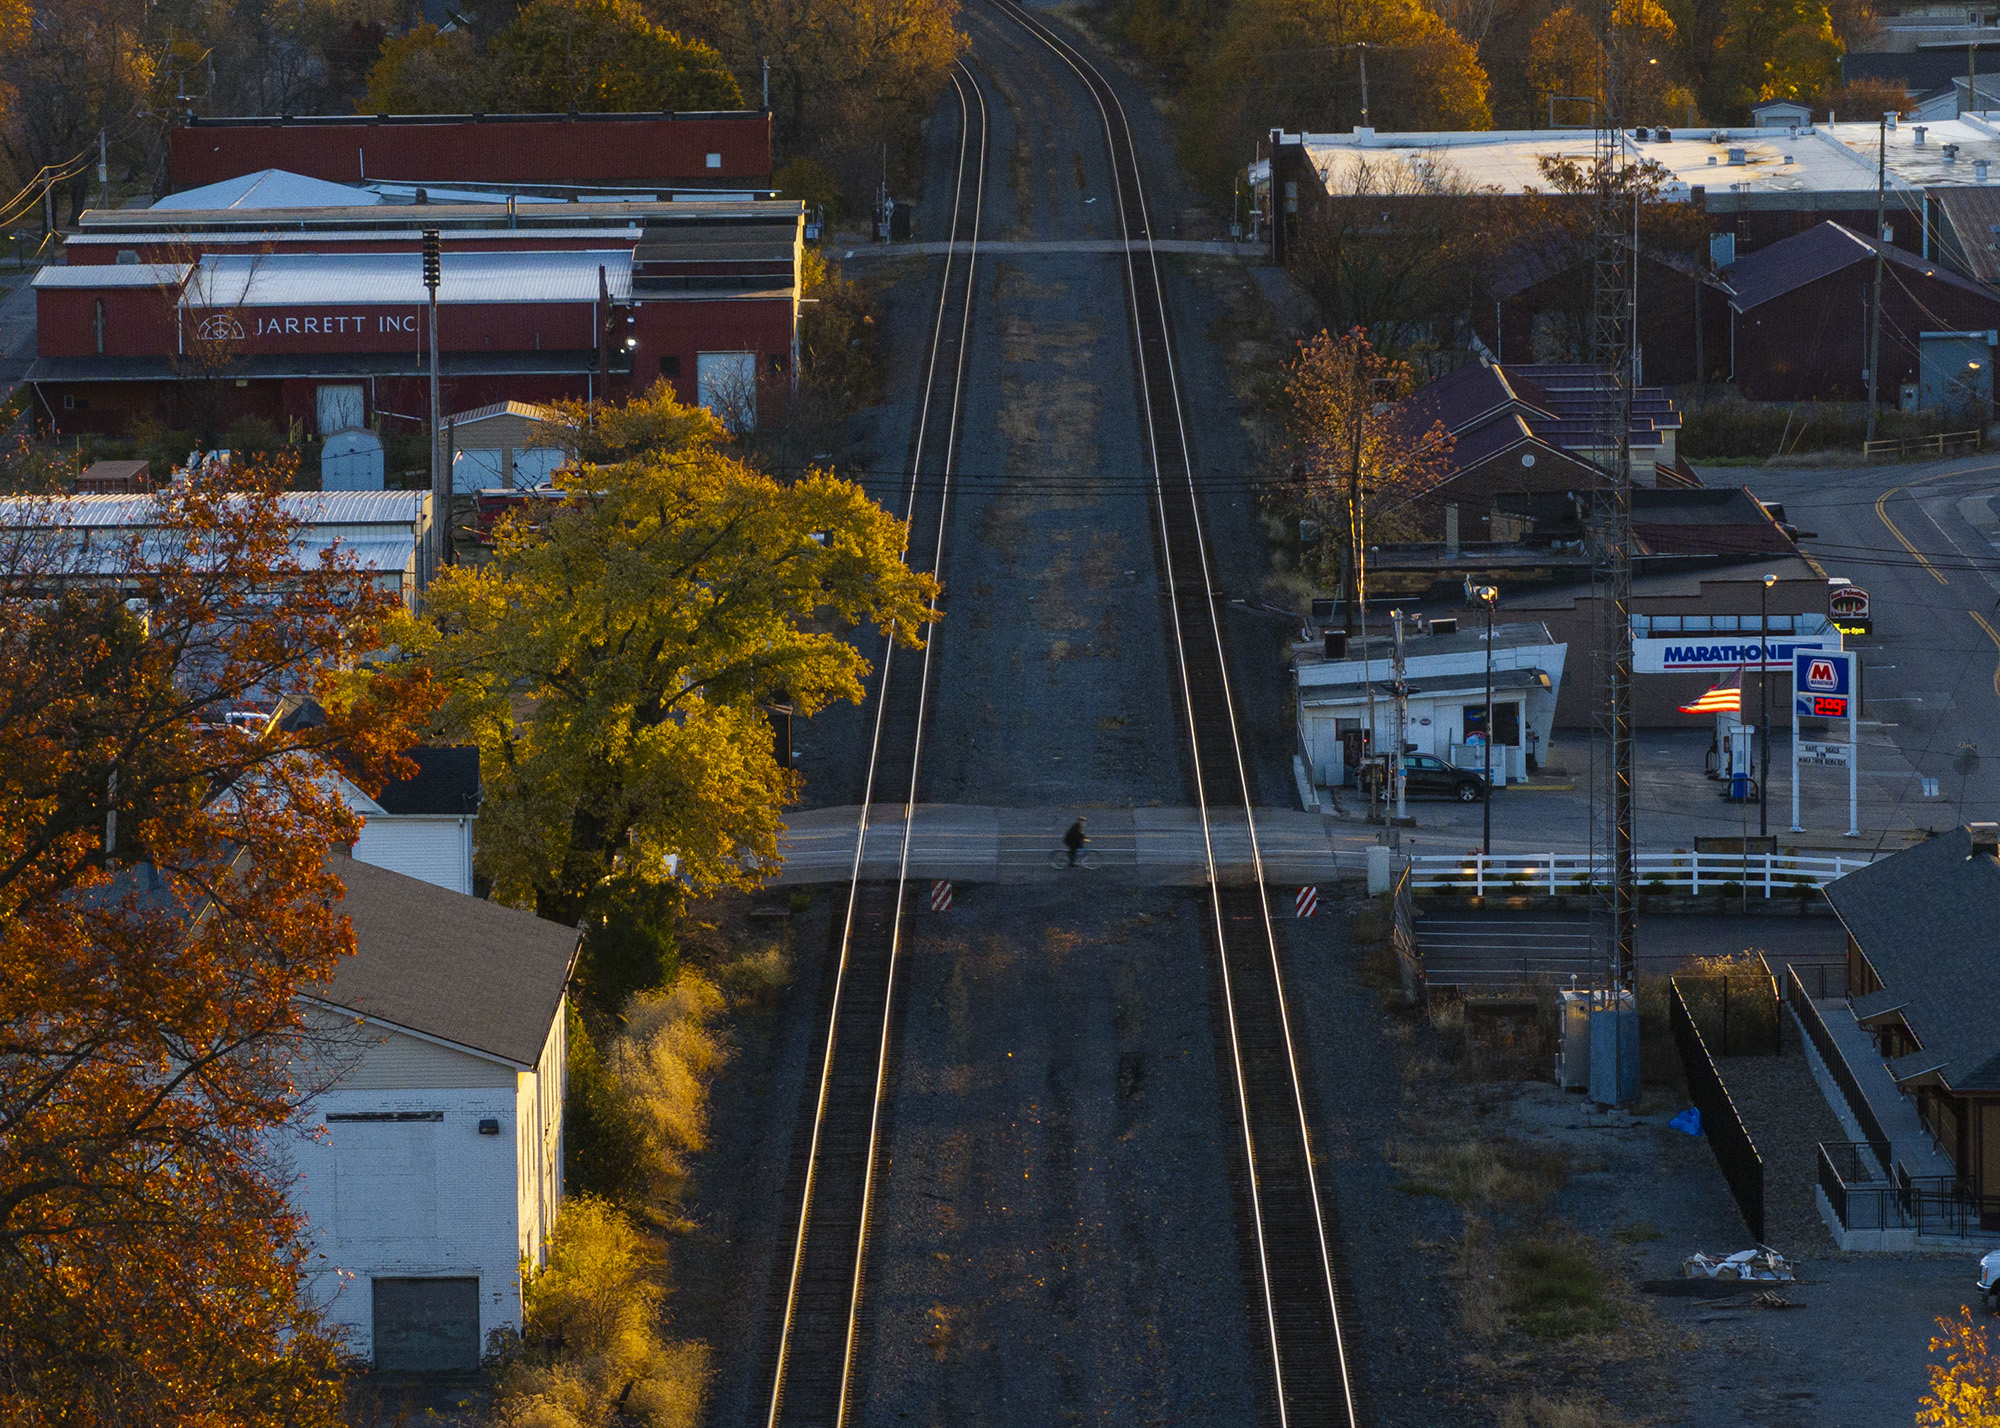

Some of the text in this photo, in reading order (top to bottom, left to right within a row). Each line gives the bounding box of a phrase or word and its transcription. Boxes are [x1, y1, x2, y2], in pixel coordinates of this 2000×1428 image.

[257, 316, 366, 336] JARRETT
[1664, 644, 1777, 663] MARATHON
[1811, 664, 1833, 681] M
